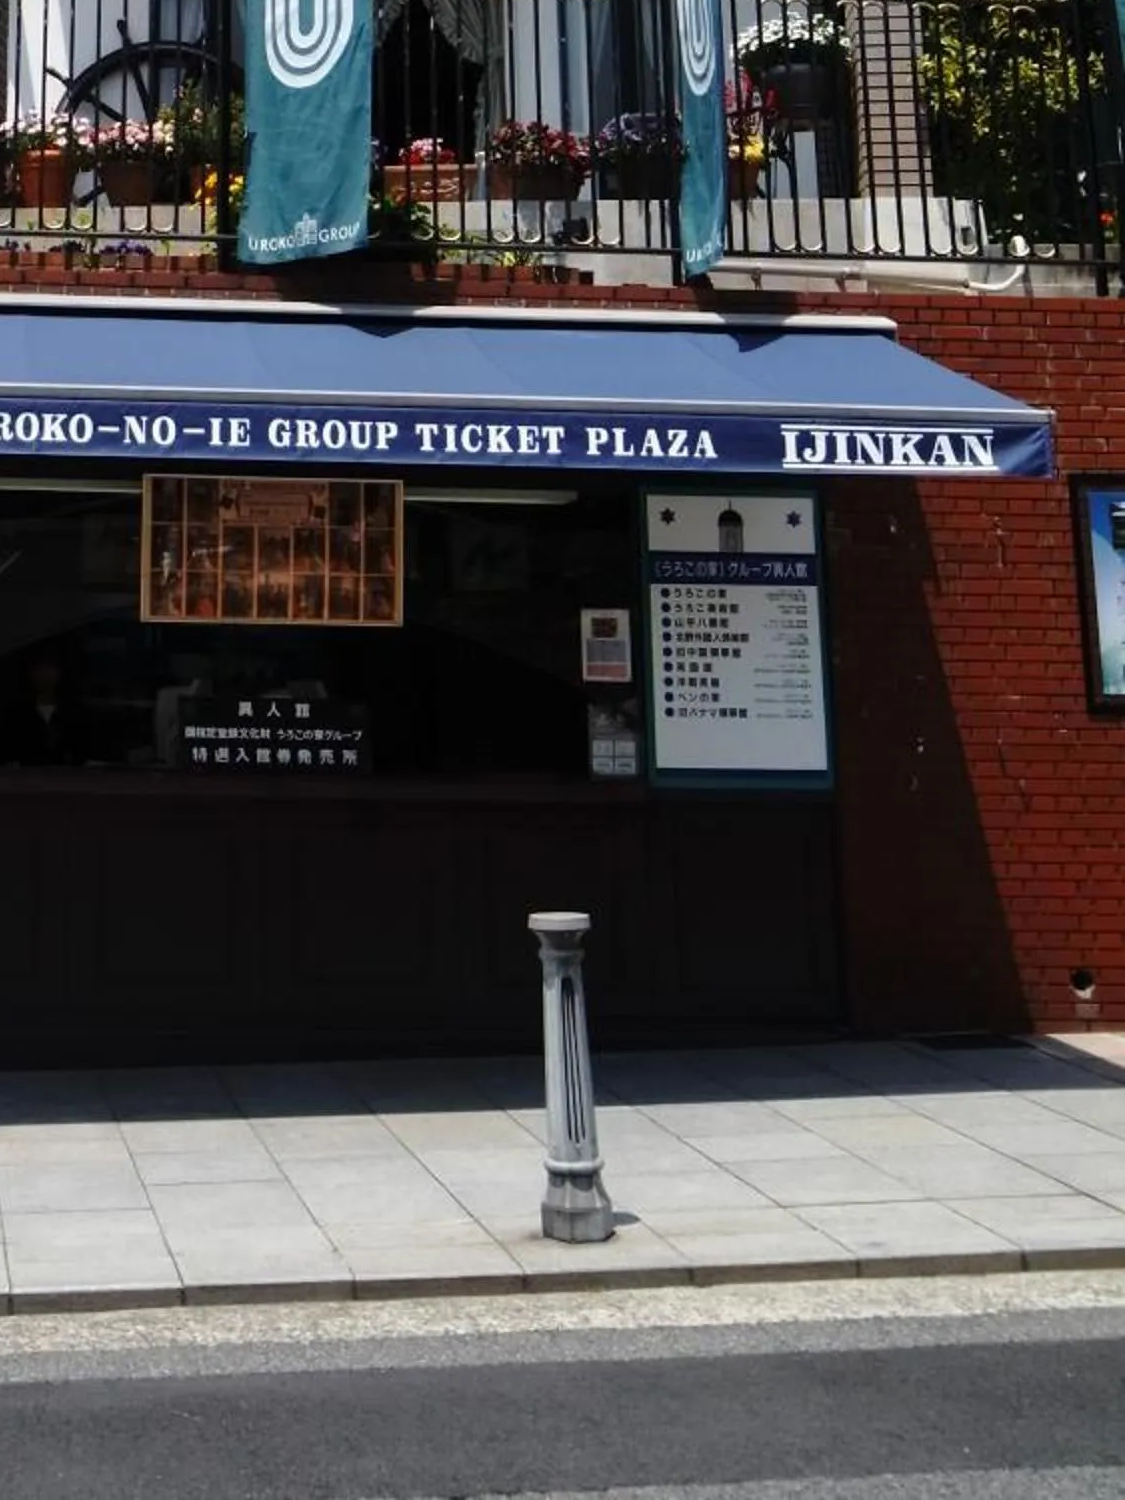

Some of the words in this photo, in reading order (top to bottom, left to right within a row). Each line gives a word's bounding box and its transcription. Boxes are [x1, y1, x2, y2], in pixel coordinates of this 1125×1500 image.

[268, 417, 399, 450] GROUP
[415, 423, 565, 454] TICKET
[586, 427, 718, 459] PLAZA
[780, 430, 994, 467] IJINKAN
